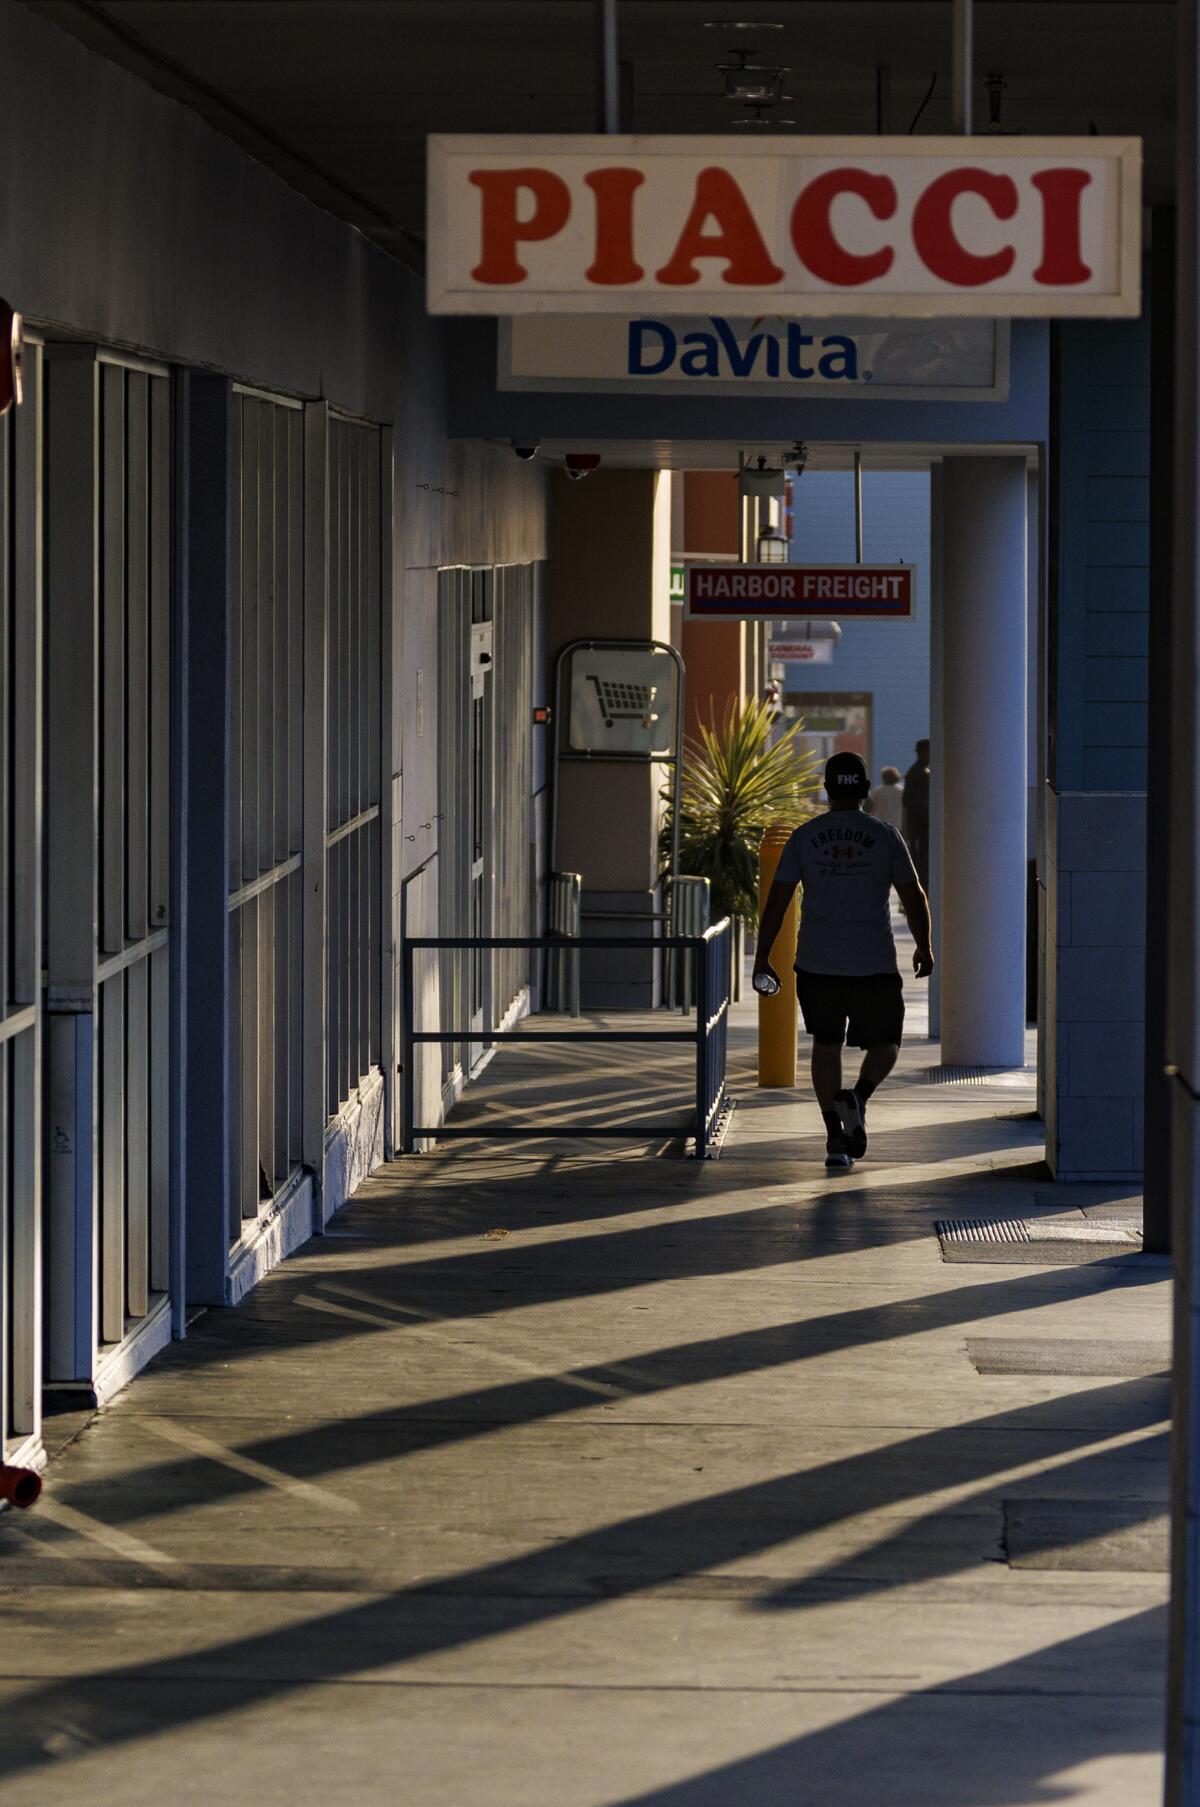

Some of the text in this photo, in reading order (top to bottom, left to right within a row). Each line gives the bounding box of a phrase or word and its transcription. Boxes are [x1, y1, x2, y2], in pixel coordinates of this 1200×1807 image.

[468, 166, 1094, 287] PIACCI
[627, 316, 858, 380] DaVita
[696, 574, 795, 598] HARBOR
[803, 575, 904, 599] FREIGHT
[837, 774, 859, 784] FHC
[811, 829, 876, 849] FREEDOM
